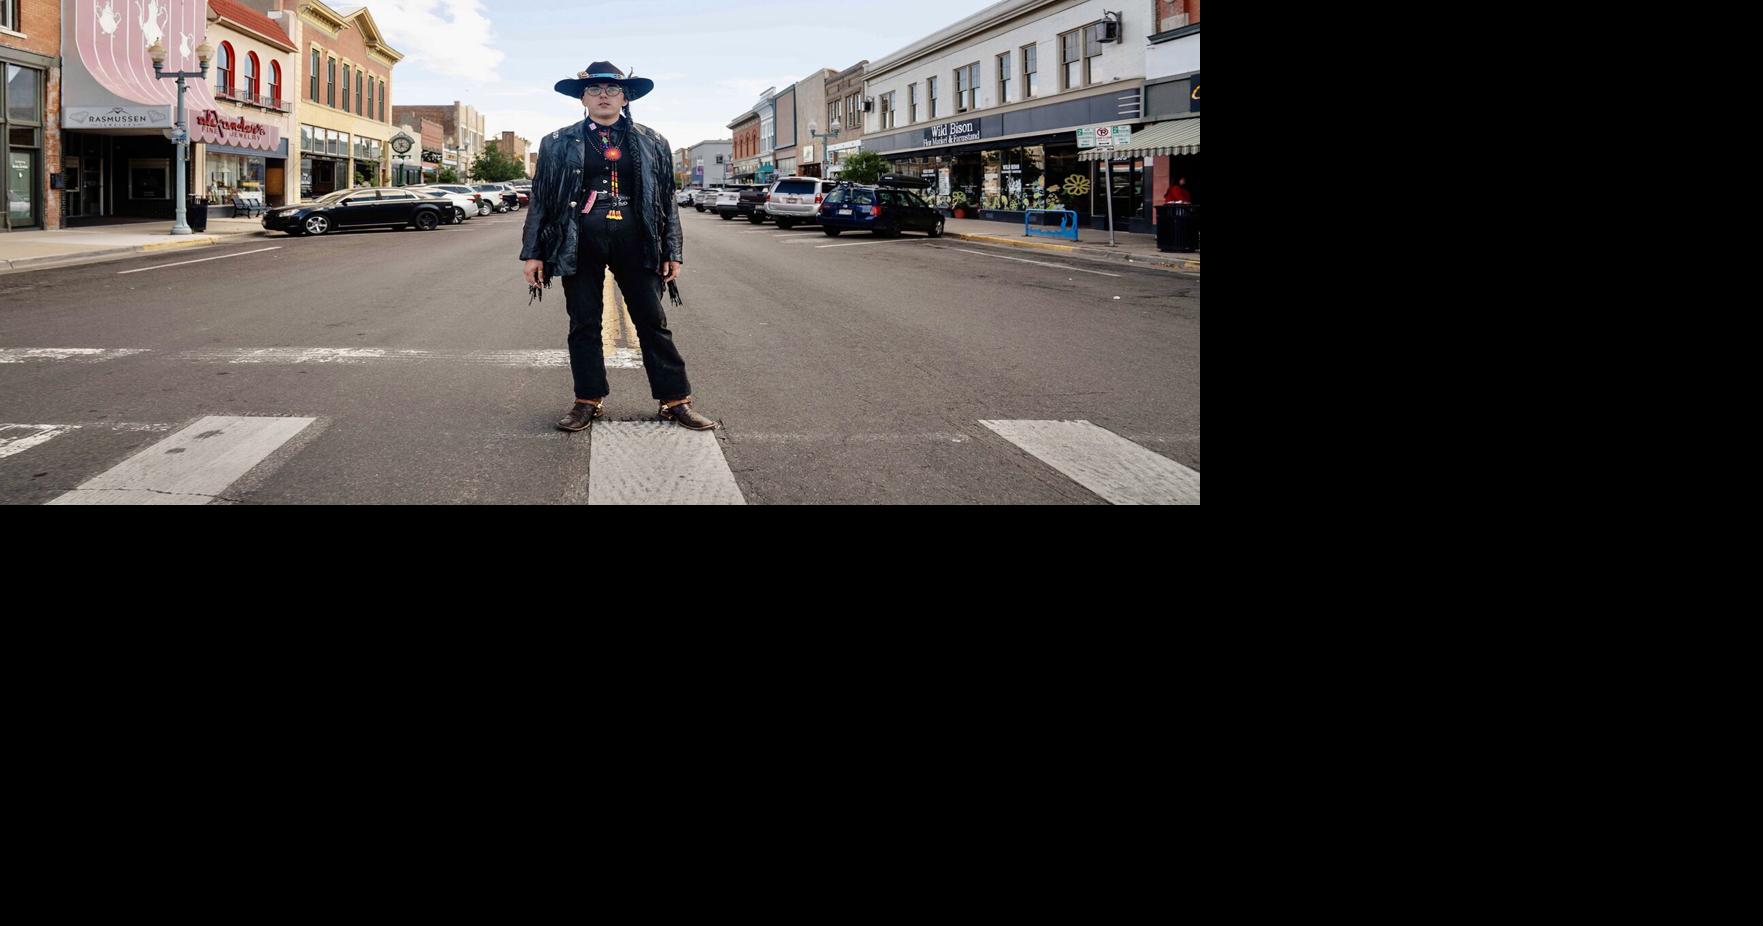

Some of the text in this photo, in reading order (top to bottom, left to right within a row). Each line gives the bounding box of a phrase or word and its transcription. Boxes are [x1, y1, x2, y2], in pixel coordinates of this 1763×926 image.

[88, 115, 146, 123] RASMUSSEN
[201, 126, 261, 140] FINE JEWELRY
[931, 122, 973, 137] Wild Bison
